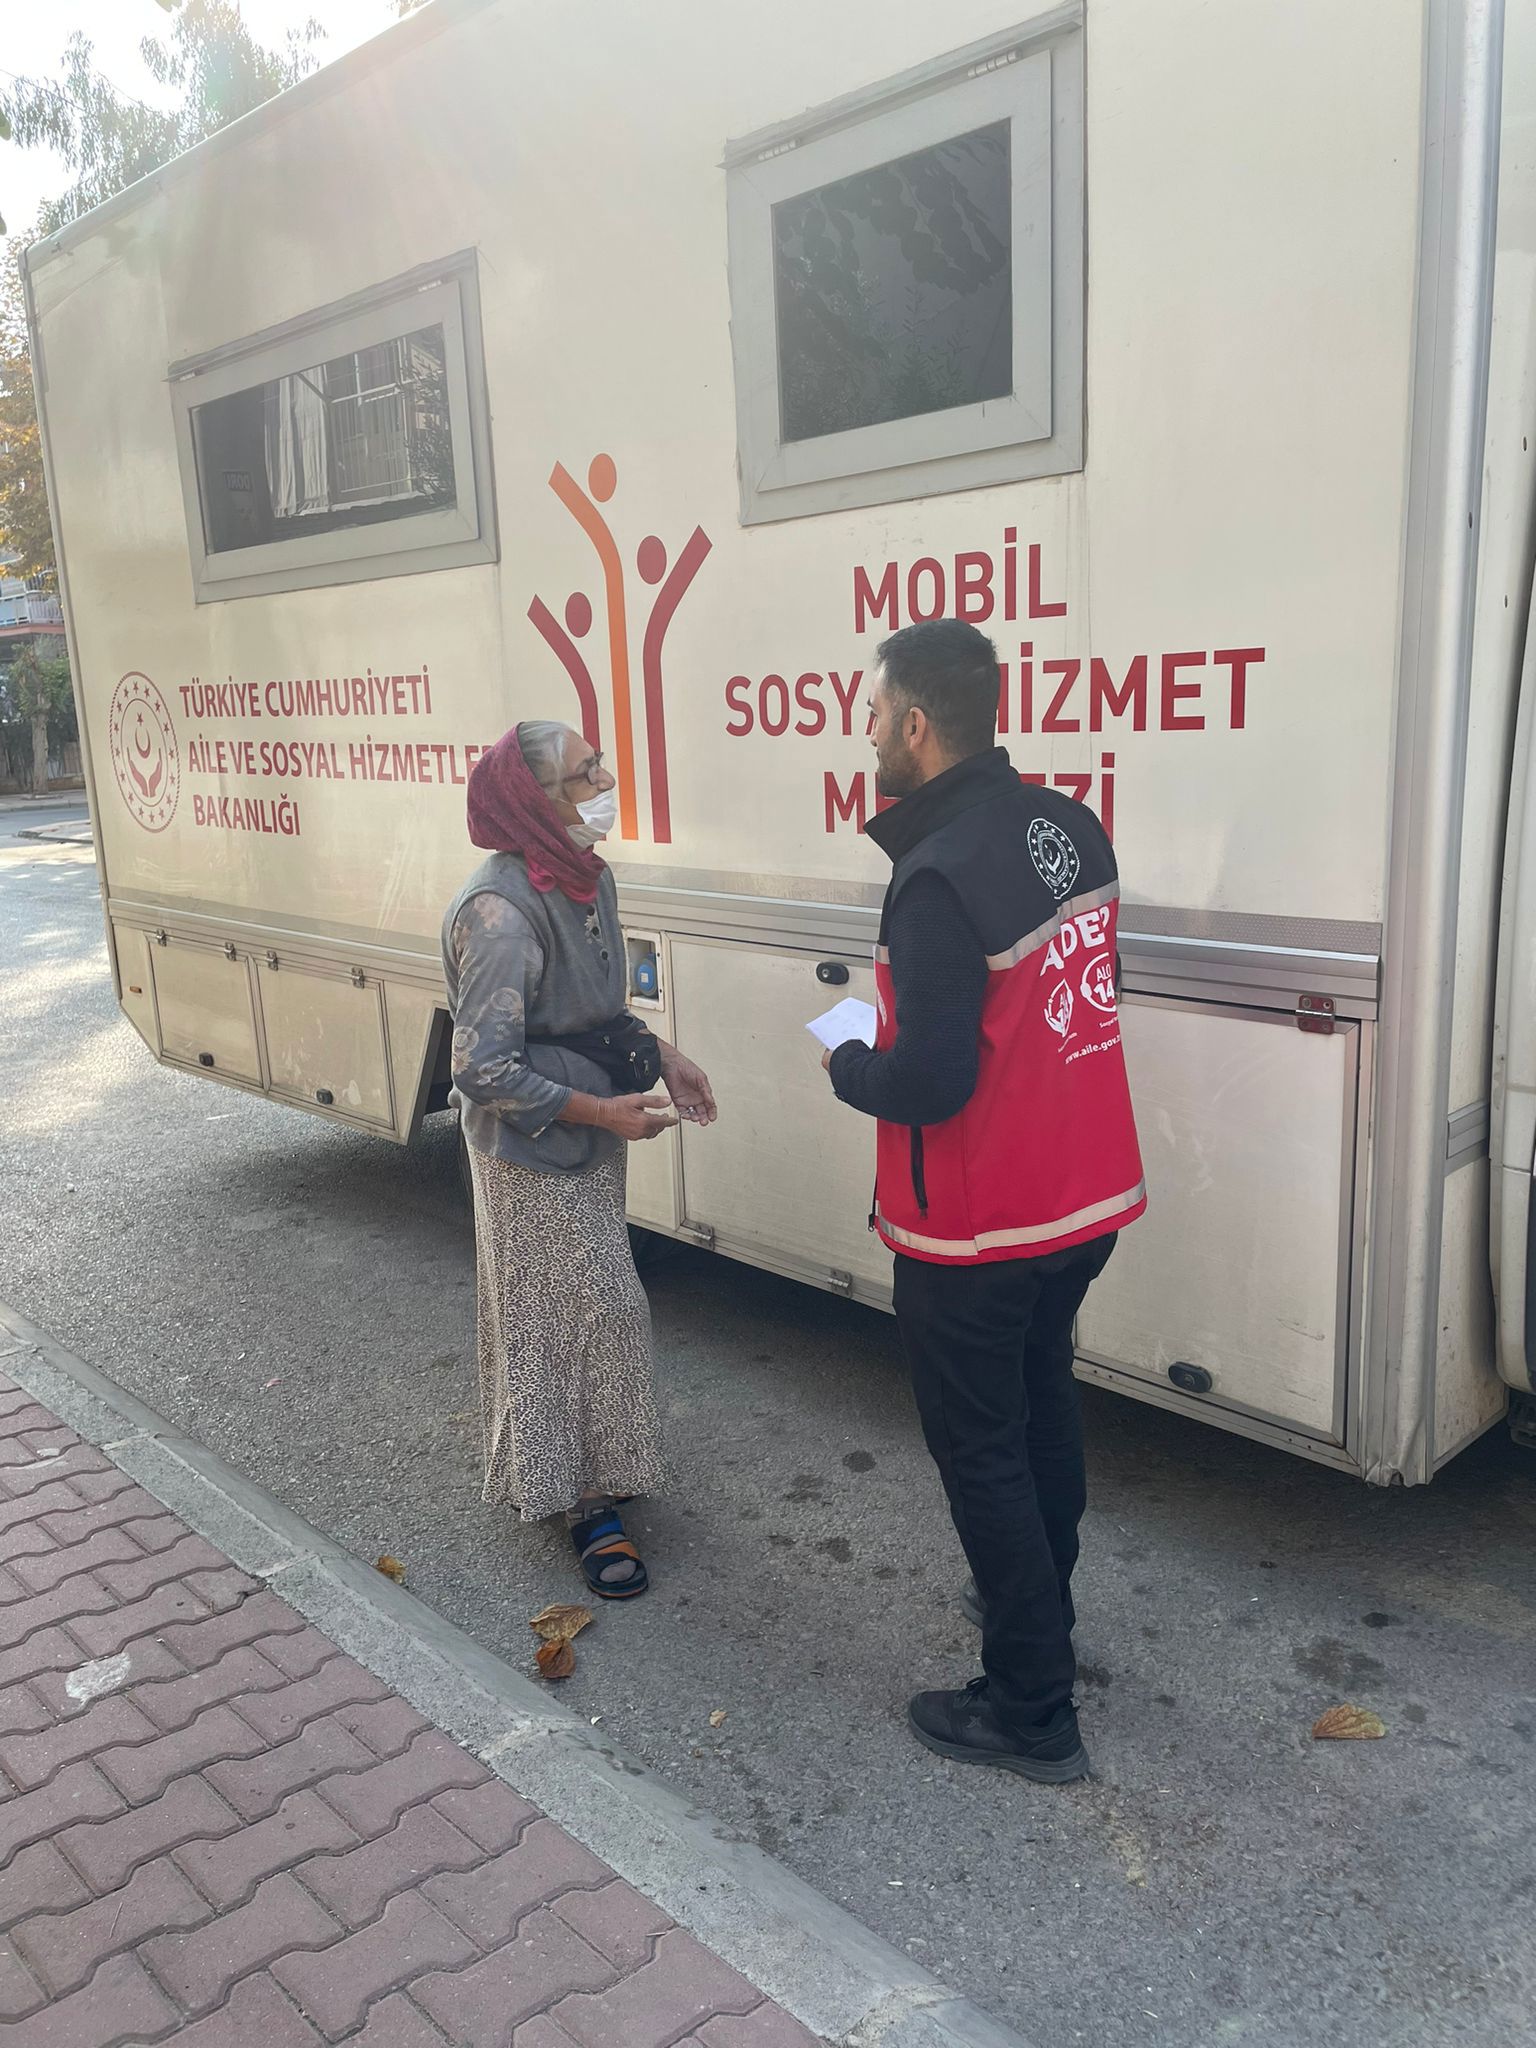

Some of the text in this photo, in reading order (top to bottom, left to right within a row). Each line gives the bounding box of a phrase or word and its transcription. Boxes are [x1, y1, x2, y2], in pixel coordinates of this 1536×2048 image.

[853, 526, 1067, 634] MOBİL
[179, 664, 432, 718] TÜRKİYE CUMHURİYETİ
[724, 670, 877, 737] SOSY
[188, 733, 492, 785] AİLE VE SOSYAL HİZMETLE
[193, 793, 301, 836] BAKANLIĞI
[1093, 978, 1116, 1004] 14
